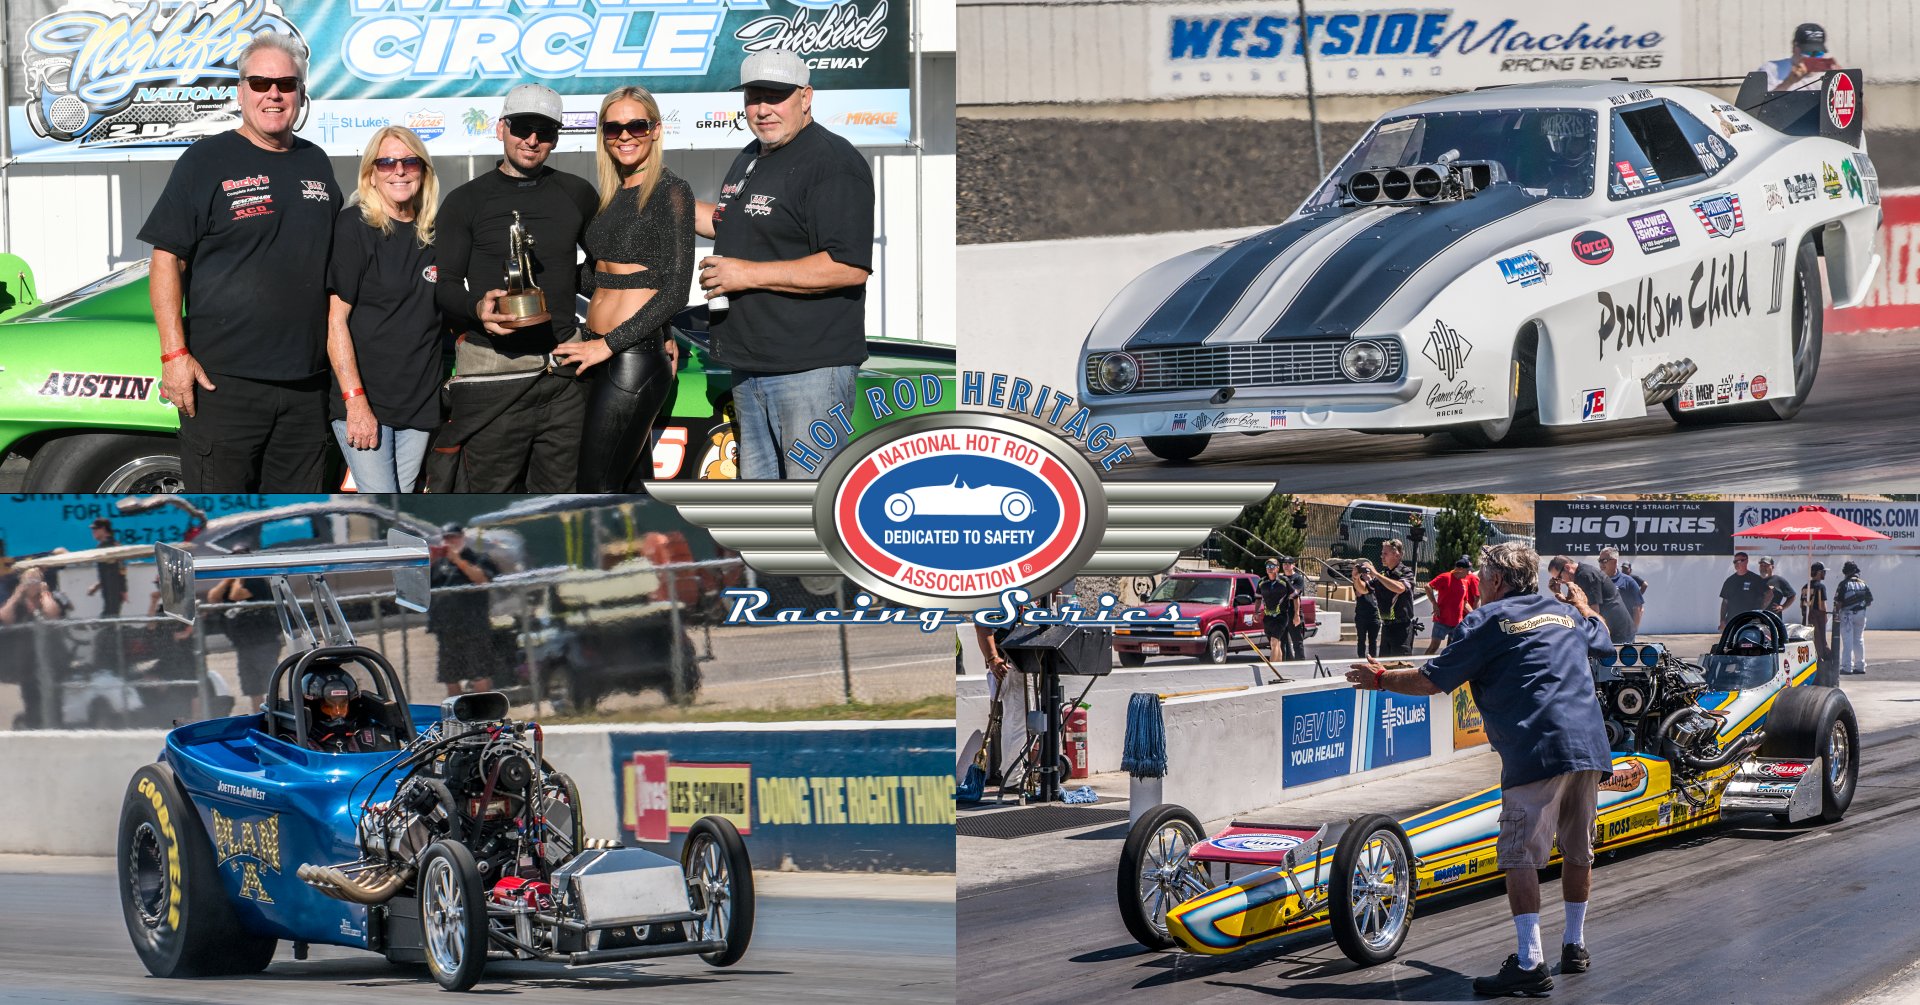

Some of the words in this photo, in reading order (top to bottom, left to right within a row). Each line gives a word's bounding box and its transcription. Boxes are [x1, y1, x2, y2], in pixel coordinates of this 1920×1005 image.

[735, 0, 888, 53] Firebird
[1169, 13, 1450, 60] WESTSIDE
[1429, 19, 1665, 57] Machine
[343, 12, 715, 79] CIRCLE
[801, 57, 869, 70] ACEWAY
[1500, 57, 1575, 73] RACING
[1580, 54, 1664, 71] ENGINES
[134, 86, 238, 102] NATIONA
[341, 117, 352, 128] St
[355, 116, 390, 128] Luke's
[409, 118, 443, 128] LUCAS
[845, 111, 899, 125] MIRAGE
[221, 174, 270, 191] Bucky's
[1704, 197, 1731, 216] PATRIOT
[1635, 213, 1669, 230] BLOWER
[1714, 213, 1732, 231] TOUR
[1638, 225, 1660, 240] SHOP
[1575, 238, 1610, 255] Torco
[1597, 277, 1684, 361] Problem
[1688, 250, 1751, 330] Child
[38, 372, 154, 401] AUSTIN
[1696, 384, 1715, 401] MGP
[1436, 408, 1463, 417] RACING
[1582, 390, 1605, 420] JE
[62, 504, 103, 521] FOR
[1550, 516, 1603, 533] BIG
[1632, 516, 1716, 533] TIRES
[1566, 543, 1591, 552] THE
[1596, 543, 1630, 552] TEAM
[1634, 543, 1658, 552] YOU
[1663, 543, 1702, 552] TRUST
[1779, 543, 1797, 552] Family
[1797, 543, 1816, 552] Ownd
[1508, 623, 1529, 633] Great
[1396, 707, 1405, 727] St
[1405, 703, 1426, 726] Luke's
[1291, 711, 1325, 745] REV
[1327, 708, 1346, 739] UP
[1290, 748, 1315, 767] YOUR
[1314, 741, 1345, 763] HEALTH
[1788, 765, 1806, 773] LINE
[756, 776, 811, 825] DOING
[810, 776, 848, 825] THE
[847, 775, 901, 825] RIGHT
[1609, 816, 1631, 838] ROSS
[211, 807, 281, 875] PLAN
[1244, 839, 1294, 847] FIGHT
[137, 777, 182, 931] GOODYEAR
[1433, 863, 1467, 882] manton
